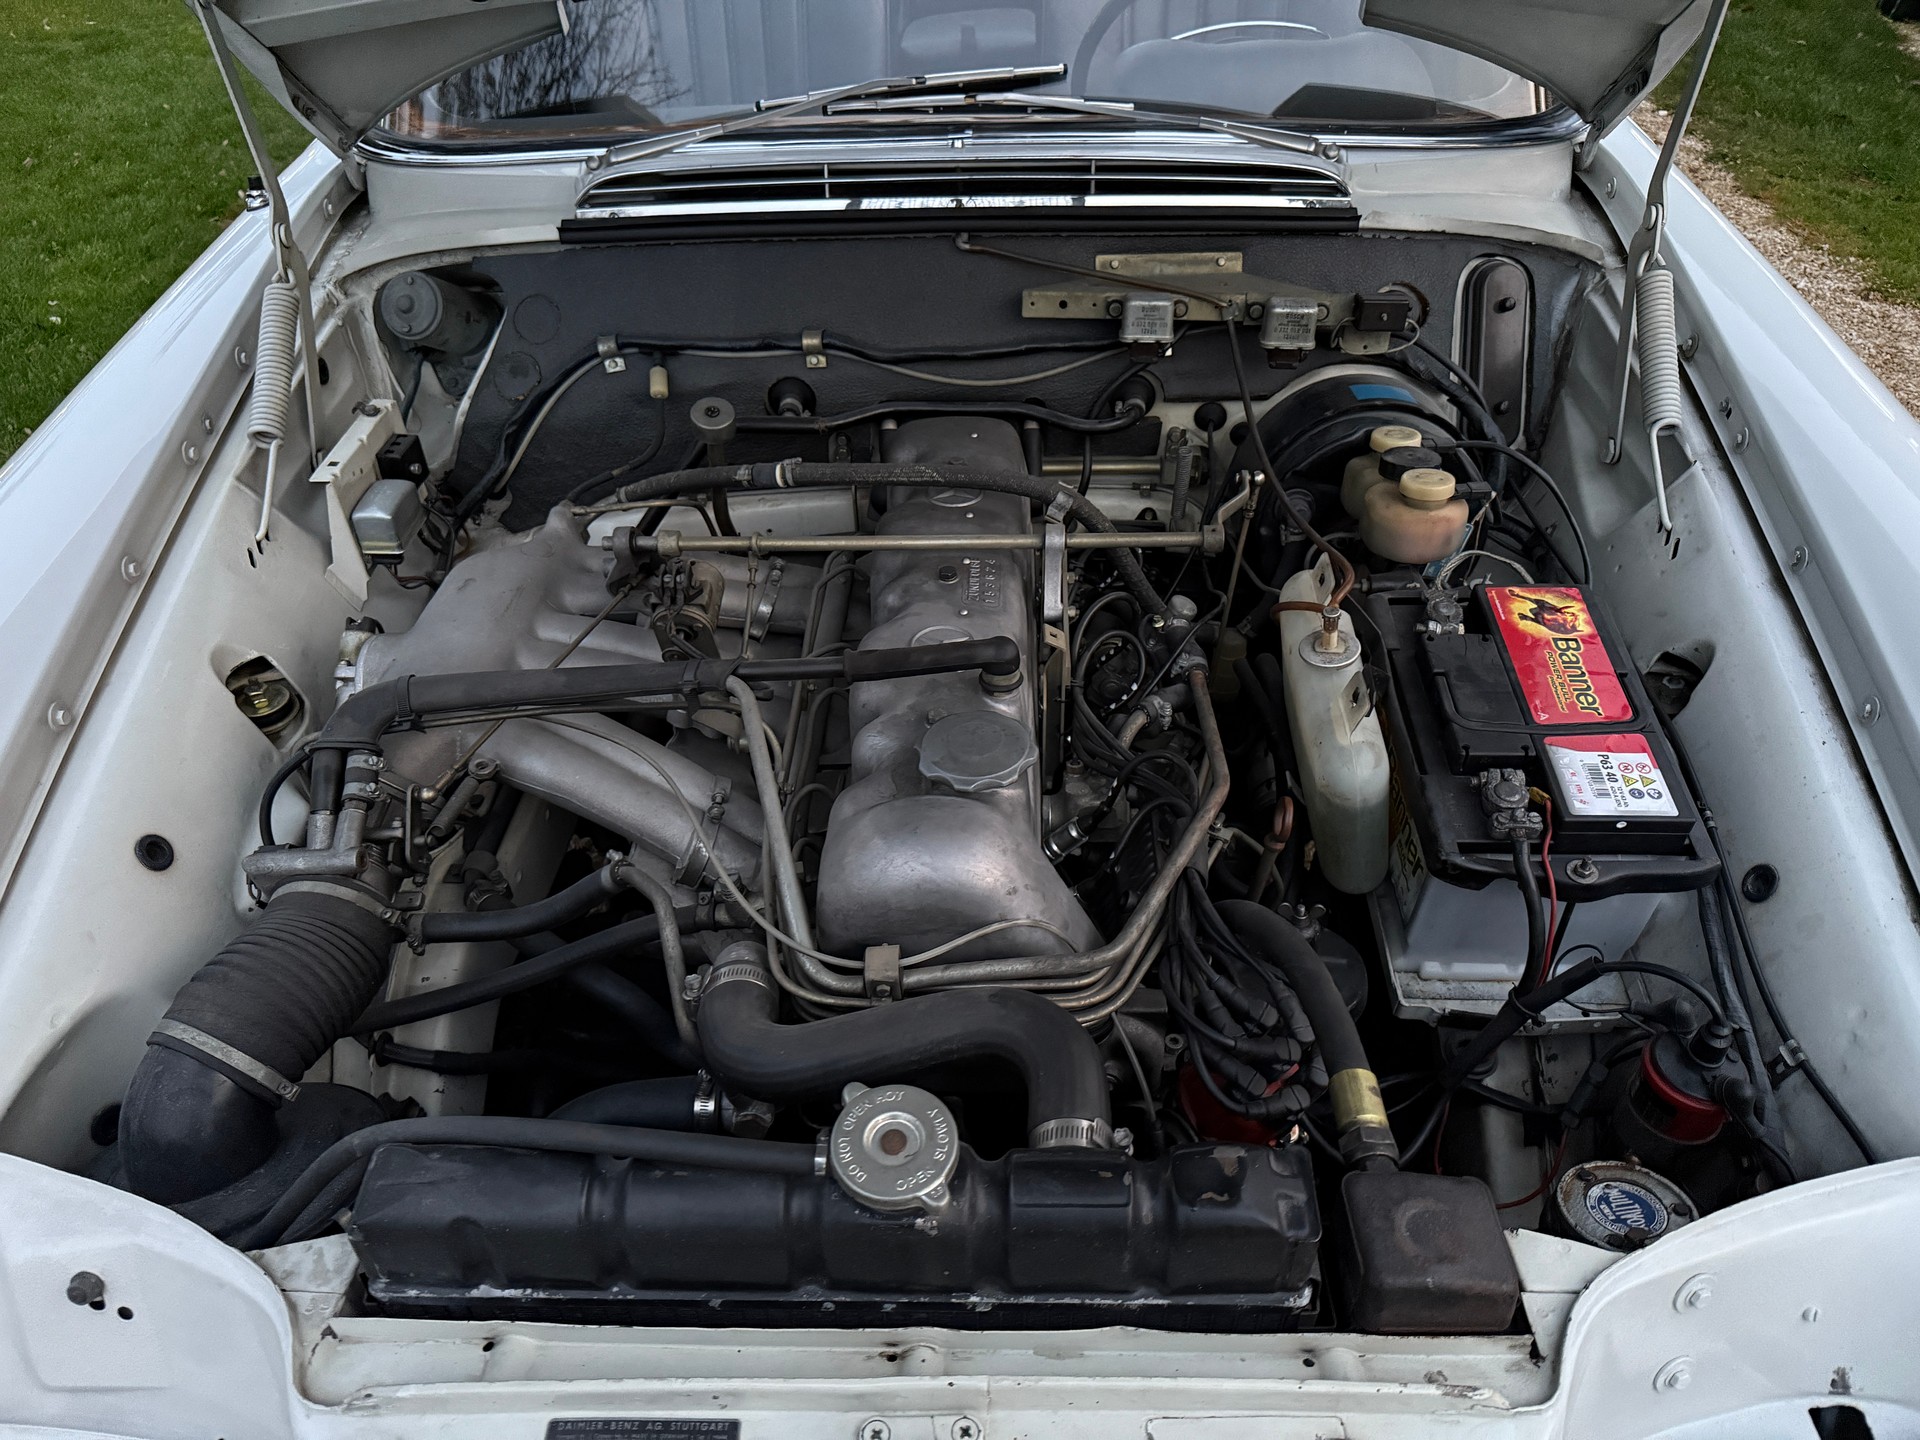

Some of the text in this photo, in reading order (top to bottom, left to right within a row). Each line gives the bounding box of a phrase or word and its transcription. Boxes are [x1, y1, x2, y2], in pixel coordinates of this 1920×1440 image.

[1546, 651, 1571, 702] POWER BULL
[1551, 637, 1604, 717] Banner
[1597, 754, 1618, 783] P63 40
[842, 1100, 873, 1131] OPEN
[838, 1137, 854, 1163] NOT
[896, 1166, 936, 1191] OPEN
[926, 1108, 950, 1161] SLOWLY
[848, 1164, 868, 1183] DO
[557, 1422, 640, 1430] DAIMLER-BENZ
[670, 1422, 730, 1432] STUTTGART
